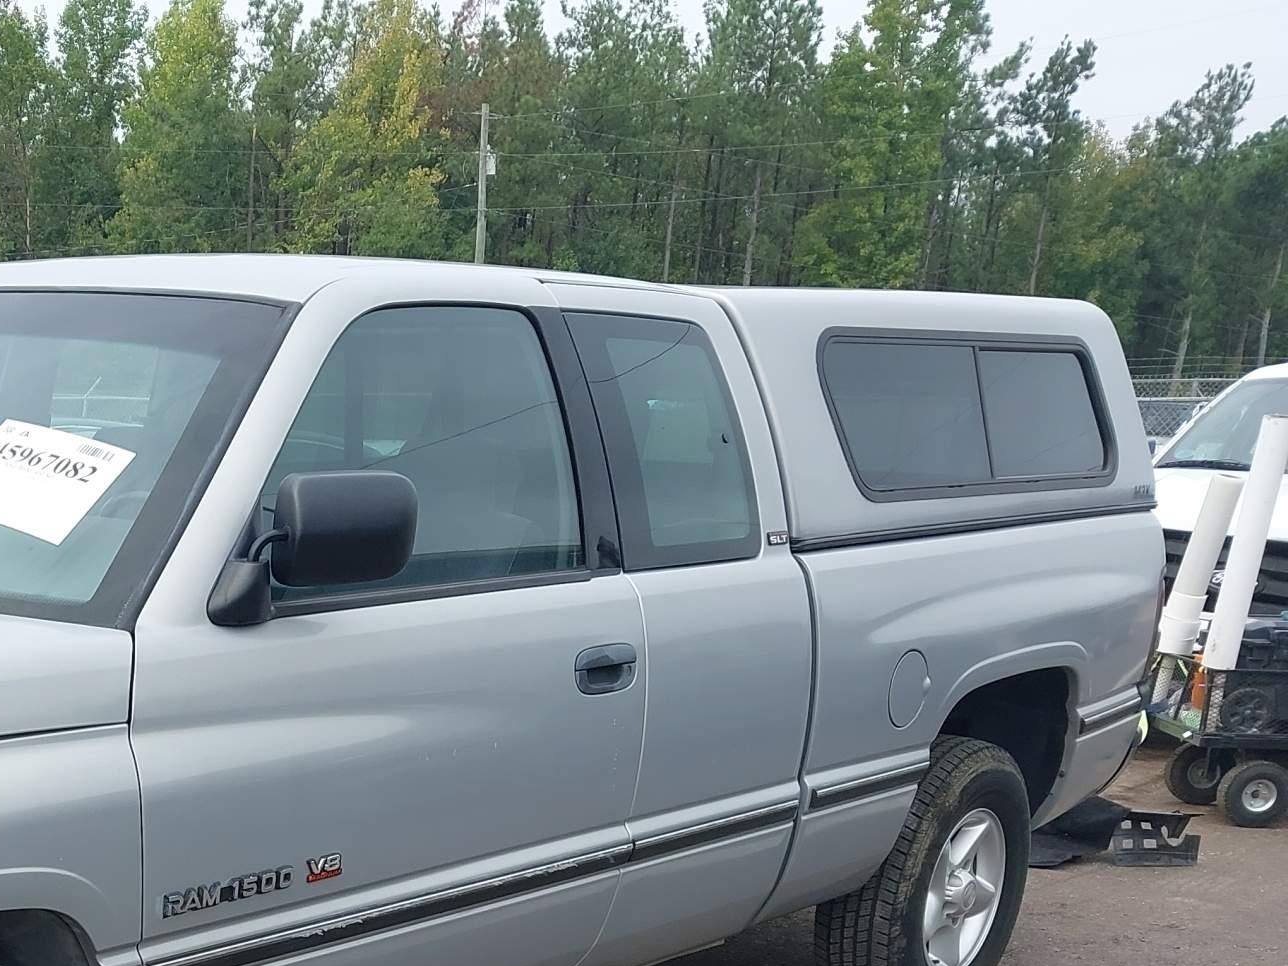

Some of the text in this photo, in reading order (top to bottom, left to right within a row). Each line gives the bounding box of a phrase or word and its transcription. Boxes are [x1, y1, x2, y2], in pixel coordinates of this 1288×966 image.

[769, 534, 788, 544] SLT
[306, 852, 342, 875] V8
[162, 865, 295, 919] RAM 1500
